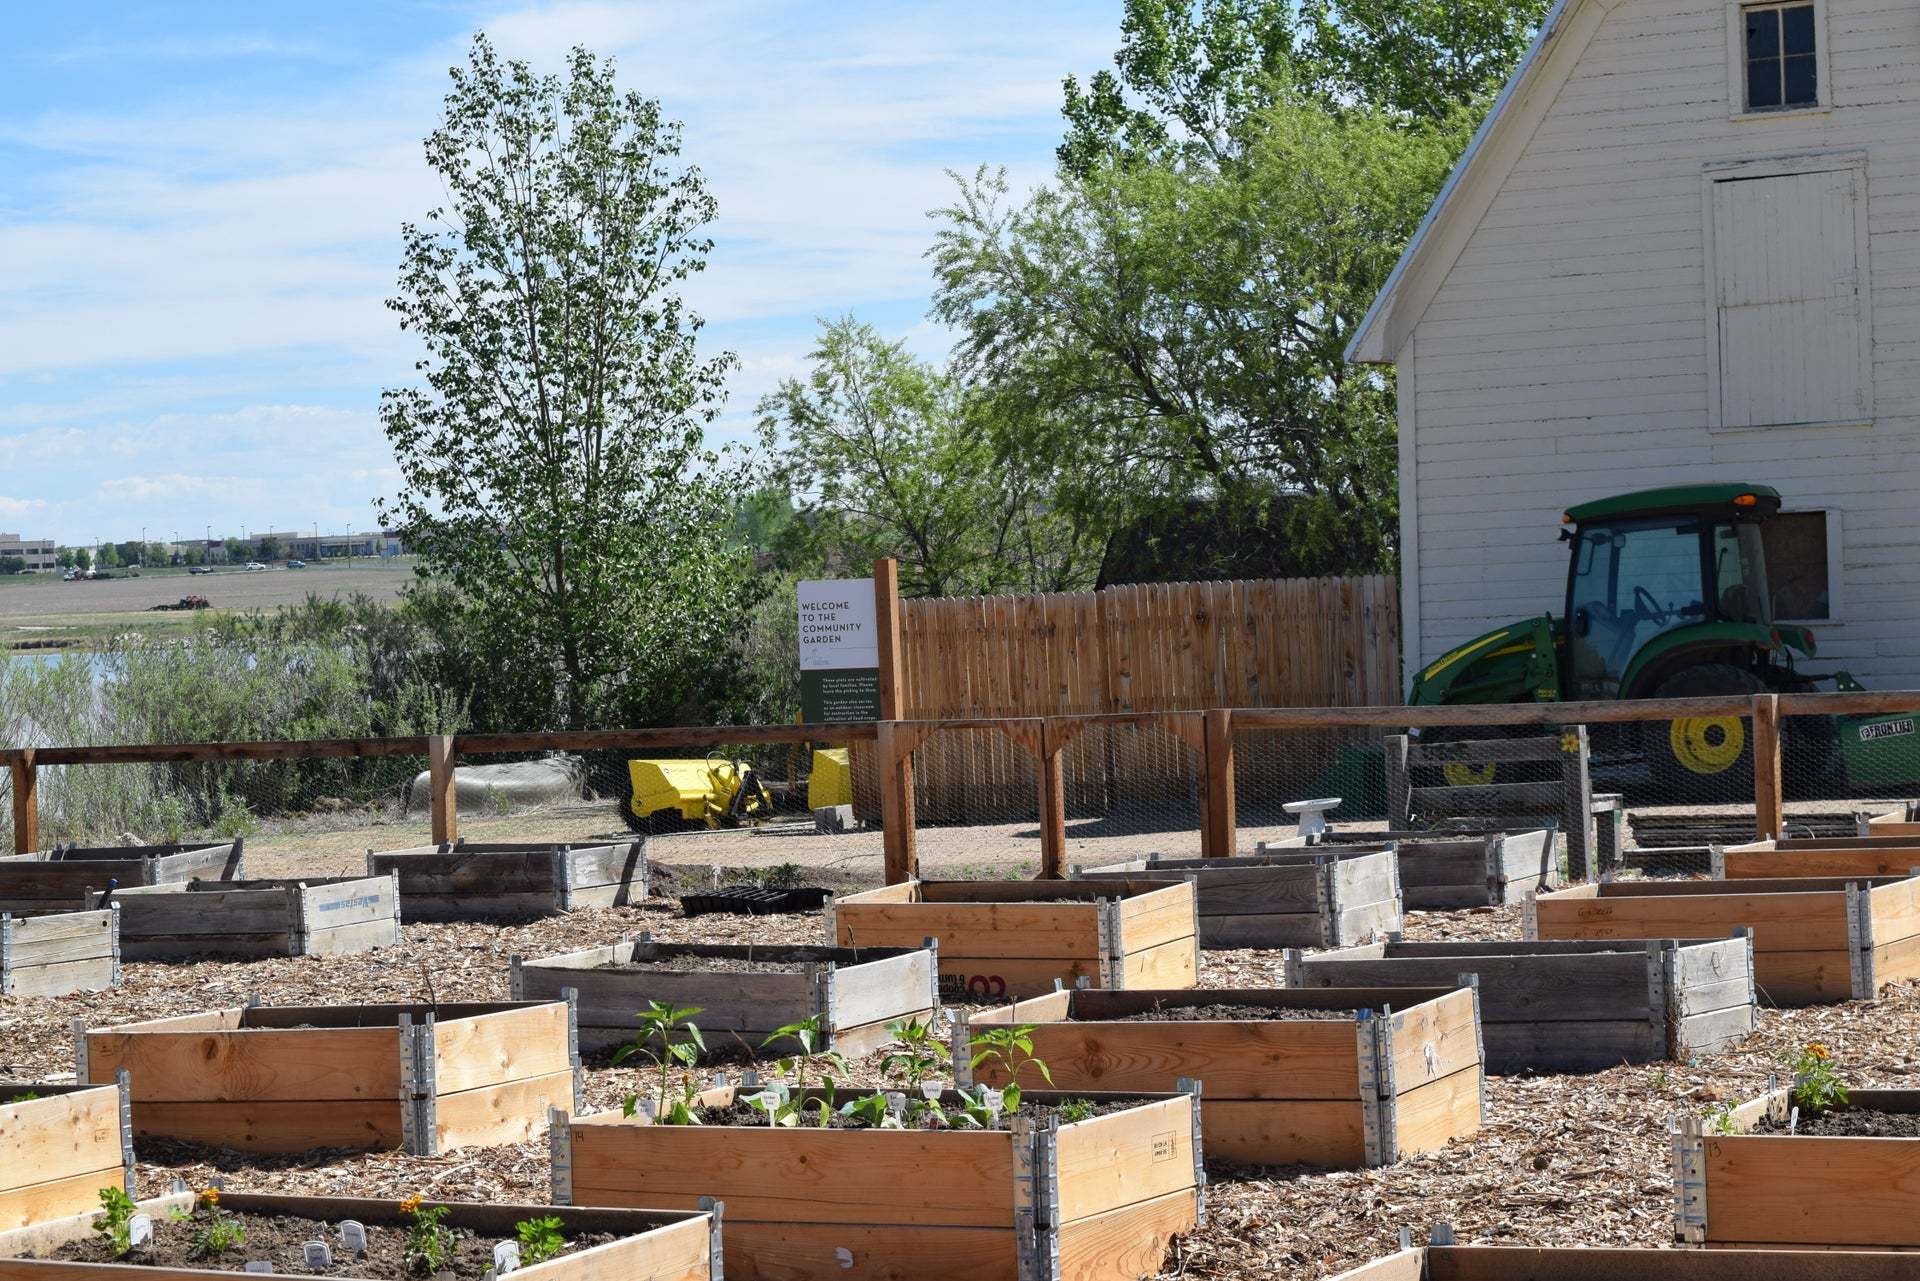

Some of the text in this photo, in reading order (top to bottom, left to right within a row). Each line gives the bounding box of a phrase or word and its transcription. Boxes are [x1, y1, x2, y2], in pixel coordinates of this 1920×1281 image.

[801, 601, 849, 610] WELCOME
[802, 613, 836, 622] TO THE
[802, 623, 861, 633] COMMUNITY
[803, 635, 841, 644] GARDEN
[1870, 720, 1914, 738] FRONTIER
[1708, 1141, 1722, 1158] 13
